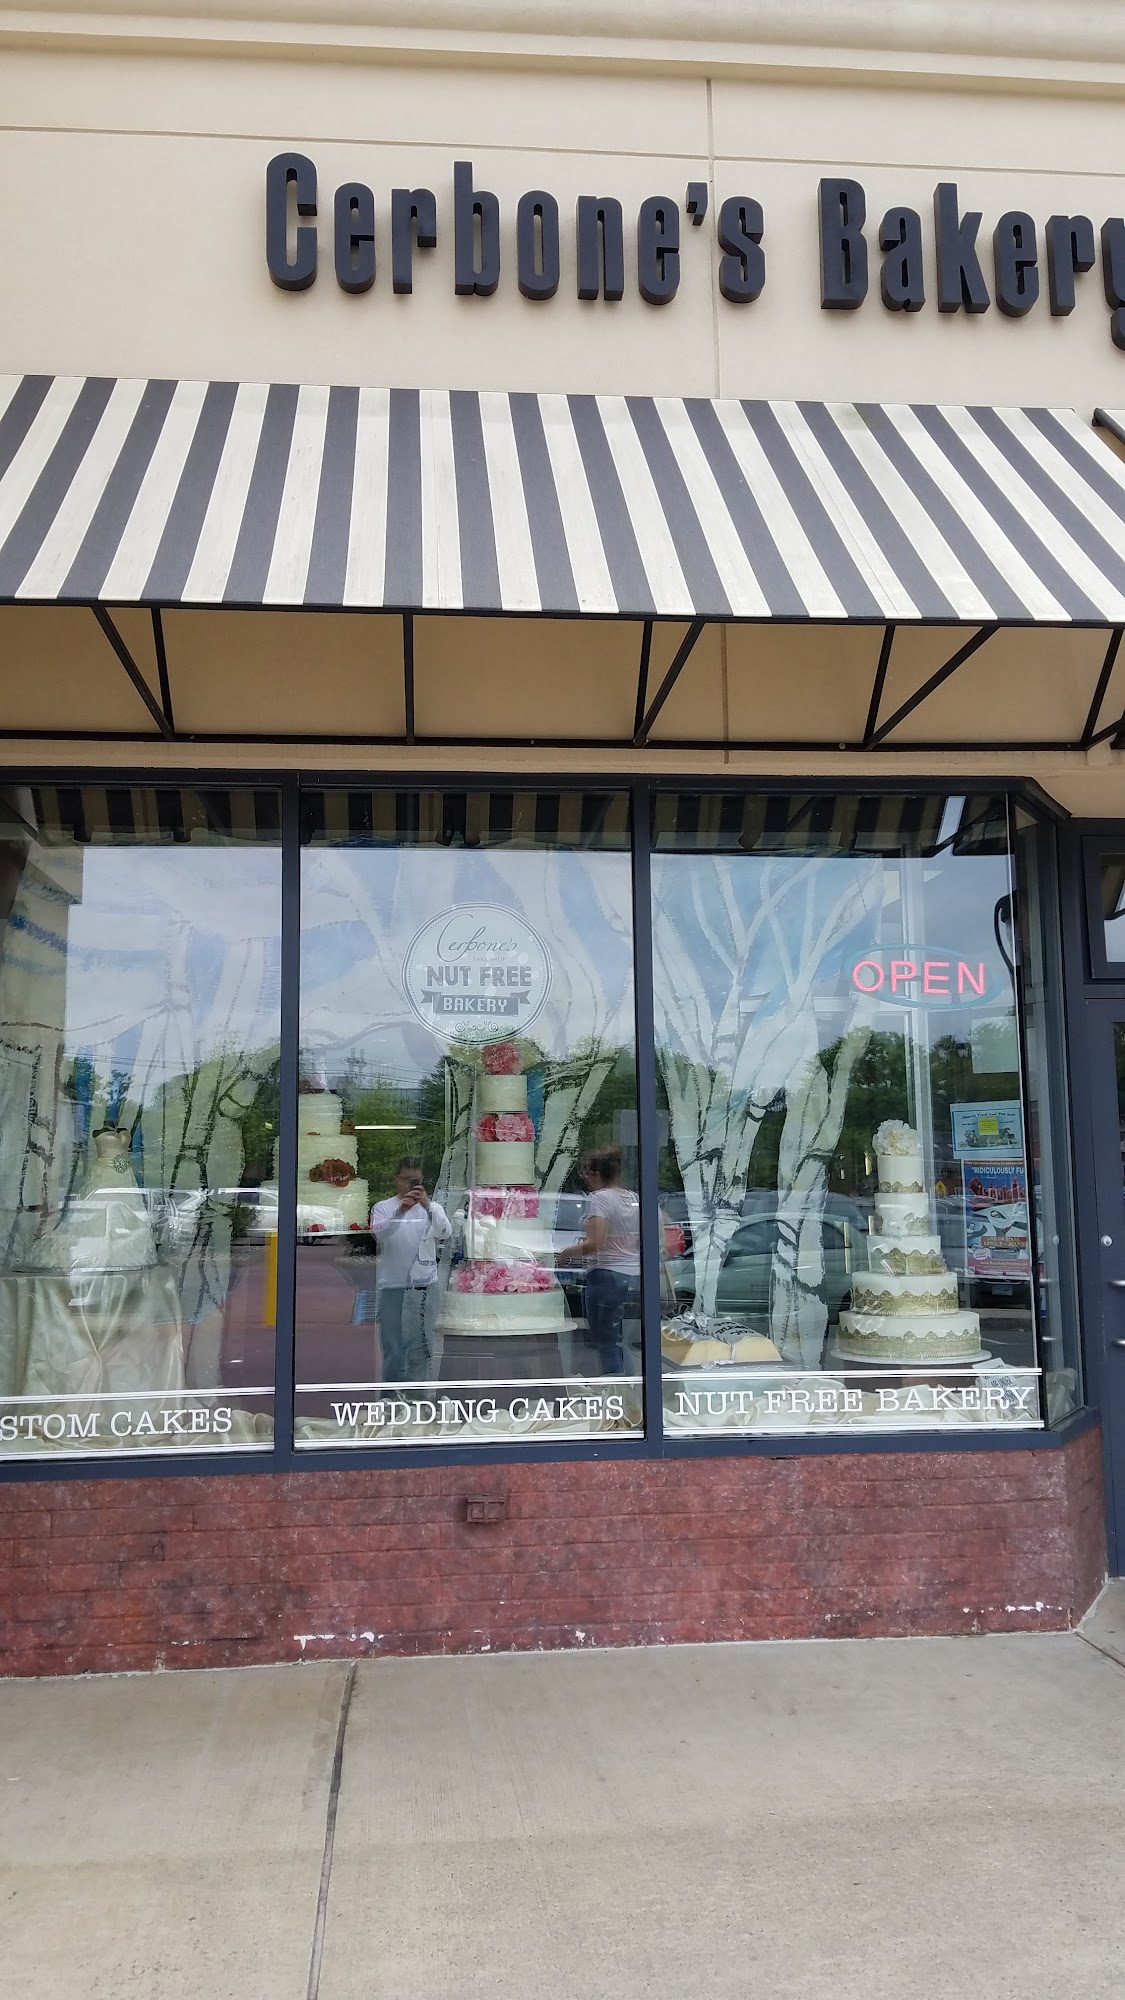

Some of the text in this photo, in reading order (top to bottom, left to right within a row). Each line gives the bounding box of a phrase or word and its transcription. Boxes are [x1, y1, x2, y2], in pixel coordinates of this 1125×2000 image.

[265, 152, 767, 306] Cerbone's
[436, 913, 518, 963] Cerbone's
[426, 965, 532, 987] NUT FREE
[852, 959, 985, 995] OPEN
[443, 997, 508, 1013] BAKERY
[331, 1396, 624, 1427] WEDDING CAKES
[674, 1391, 754, 1417] NUT
[763, 1388, 864, 1414] FREE
[874, 1387, 1035, 1413] BAKERY
[110, 1407, 232, 1437] CAKES
